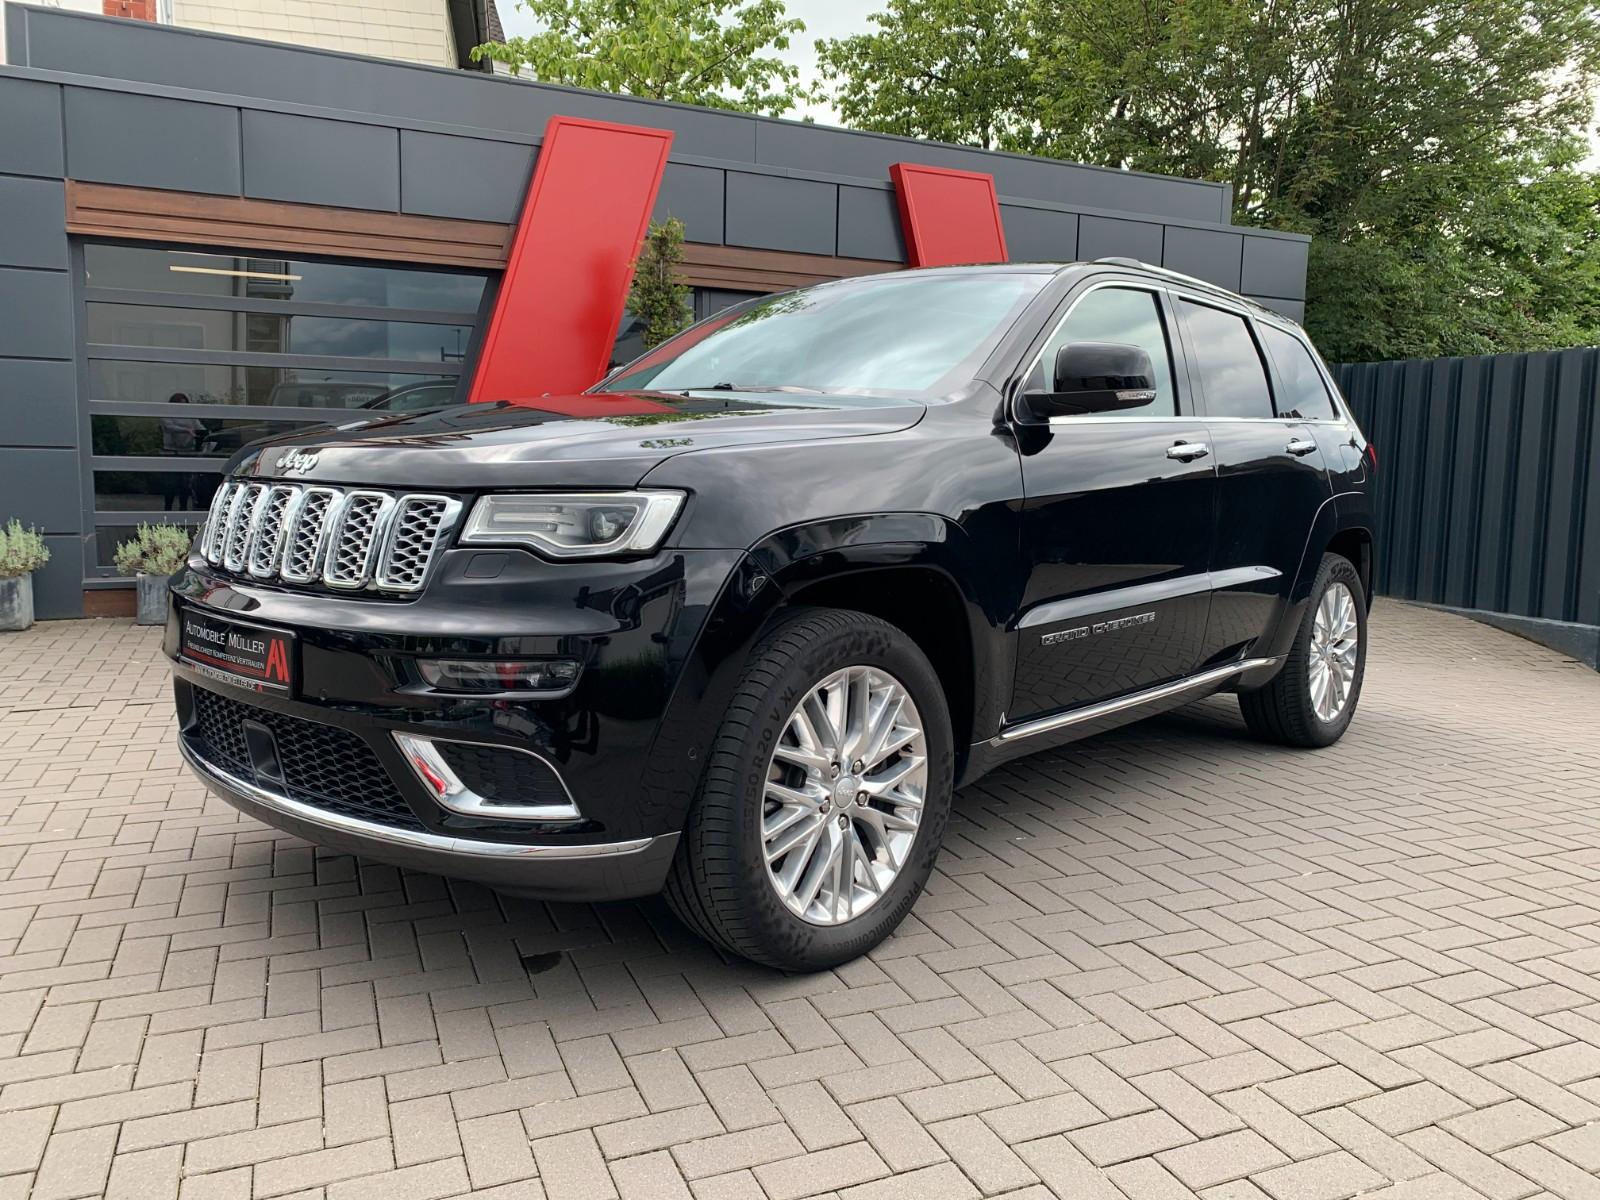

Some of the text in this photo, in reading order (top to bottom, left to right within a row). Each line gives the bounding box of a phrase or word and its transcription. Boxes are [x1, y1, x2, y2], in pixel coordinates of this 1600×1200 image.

[276, 448, 319, 475] Jeep
[186, 619, 265, 655] AUTOMOBILE MÜLLER
[1041, 611, 1156, 646] GRAND CHEROKEE
